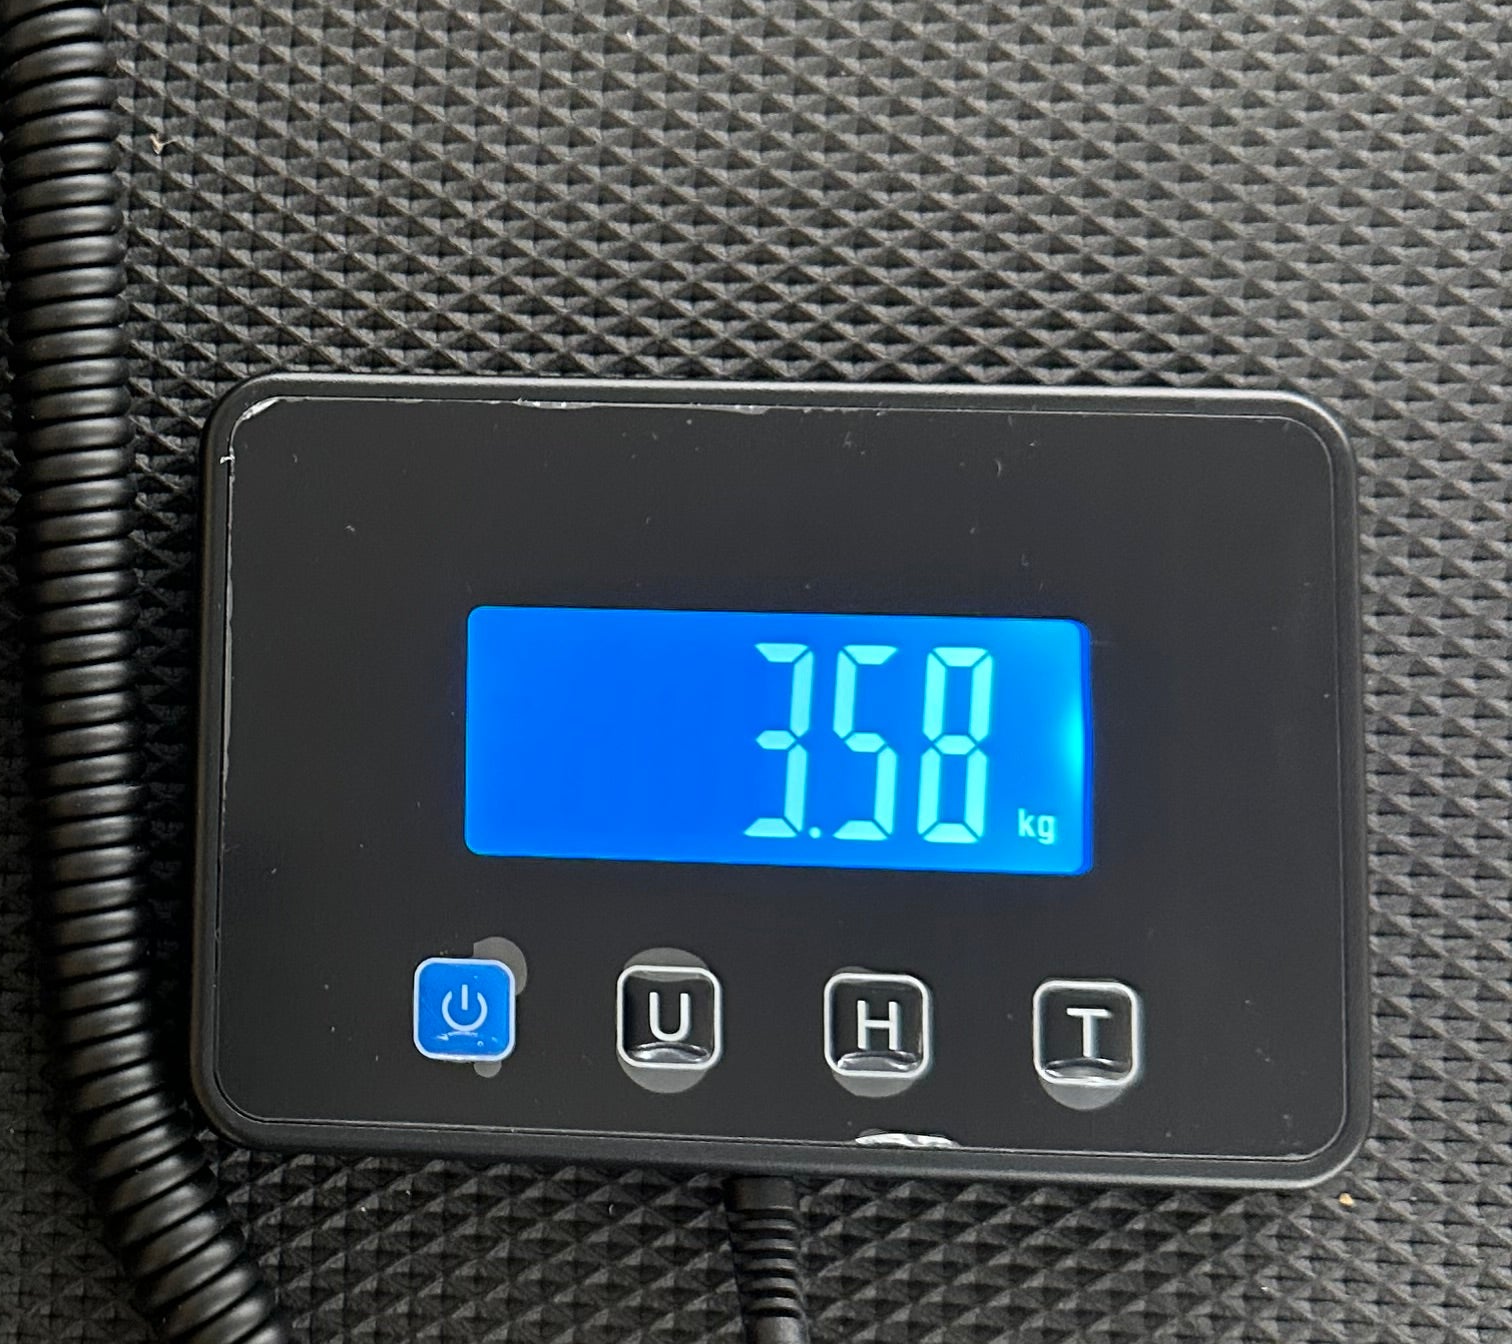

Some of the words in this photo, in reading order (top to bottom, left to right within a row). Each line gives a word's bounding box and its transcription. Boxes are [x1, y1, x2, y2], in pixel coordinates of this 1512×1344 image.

[743, 642, 993, 844] 3.58
[1018, 808, 1056, 844] kg
[648, 991, 690, 1043] U
[857, 999, 900, 1051] H
[1066, 1007, 1111, 1057] T
